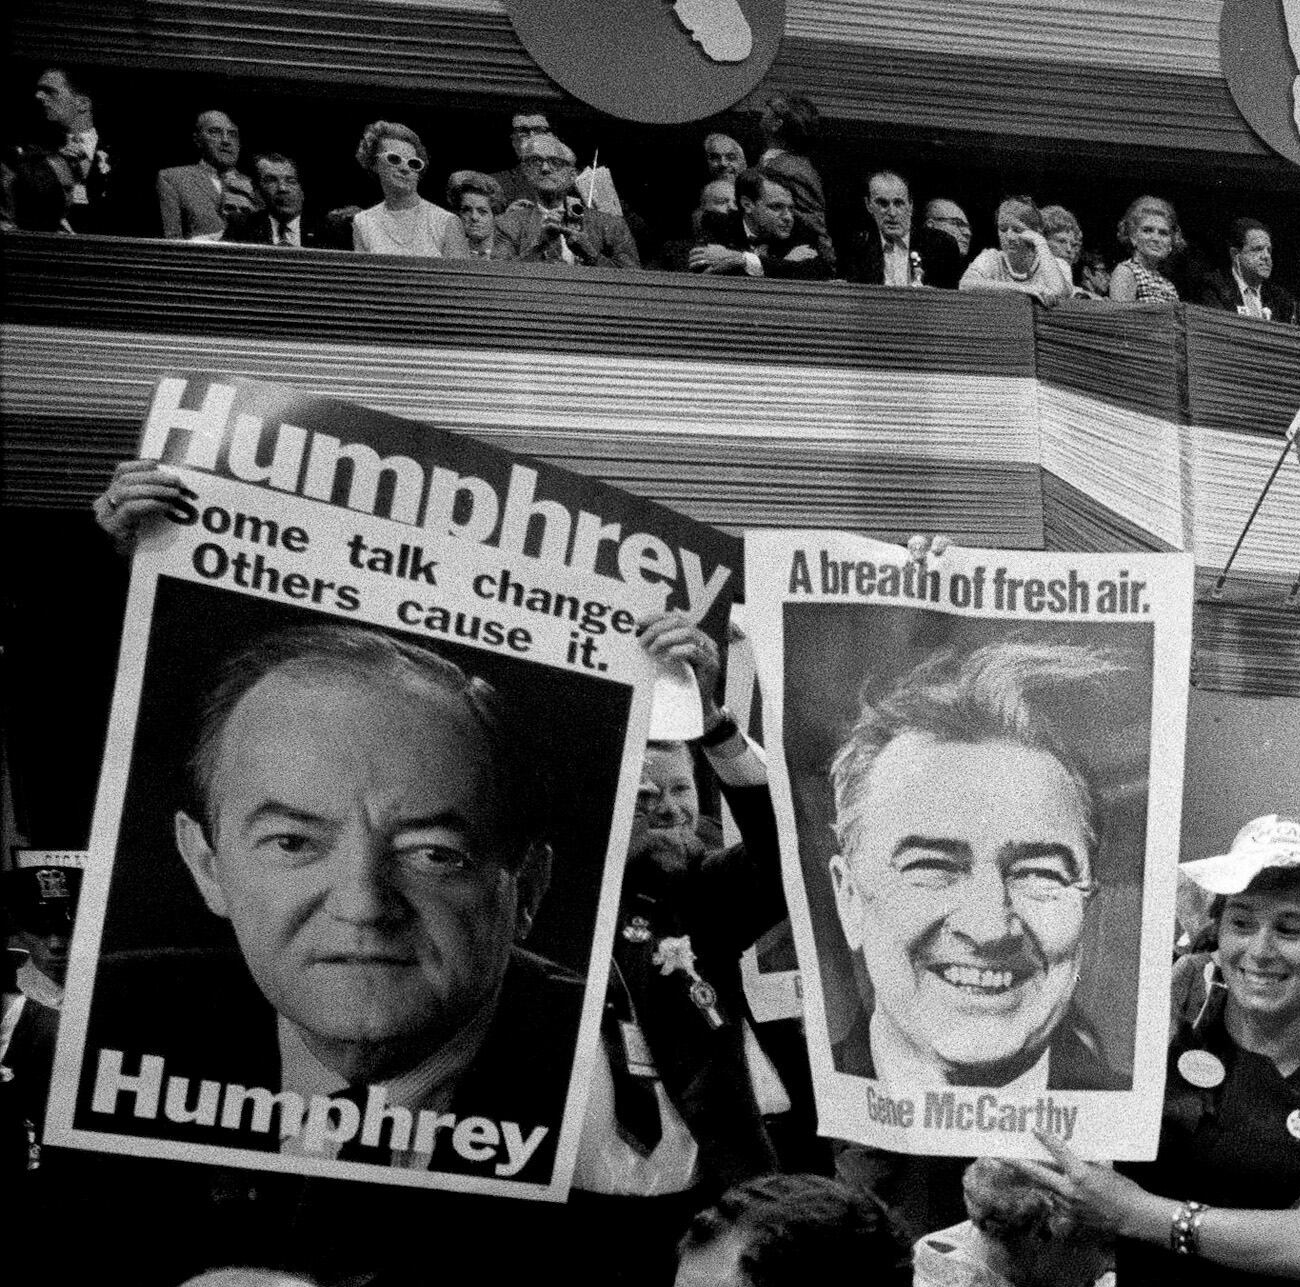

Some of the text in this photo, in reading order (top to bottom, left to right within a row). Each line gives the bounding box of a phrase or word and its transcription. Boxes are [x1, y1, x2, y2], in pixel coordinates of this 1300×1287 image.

[139, 378, 732, 630] Humphrey
[349, 533, 438, 586] talk
[788, 549, 1151, 614] A breath of fresh air.
[191, 543, 609, 672] Others cause it.
[91, 1050, 549, 1175] Humphrey
[867, 1086, 1078, 1140] Gene McCarthy
